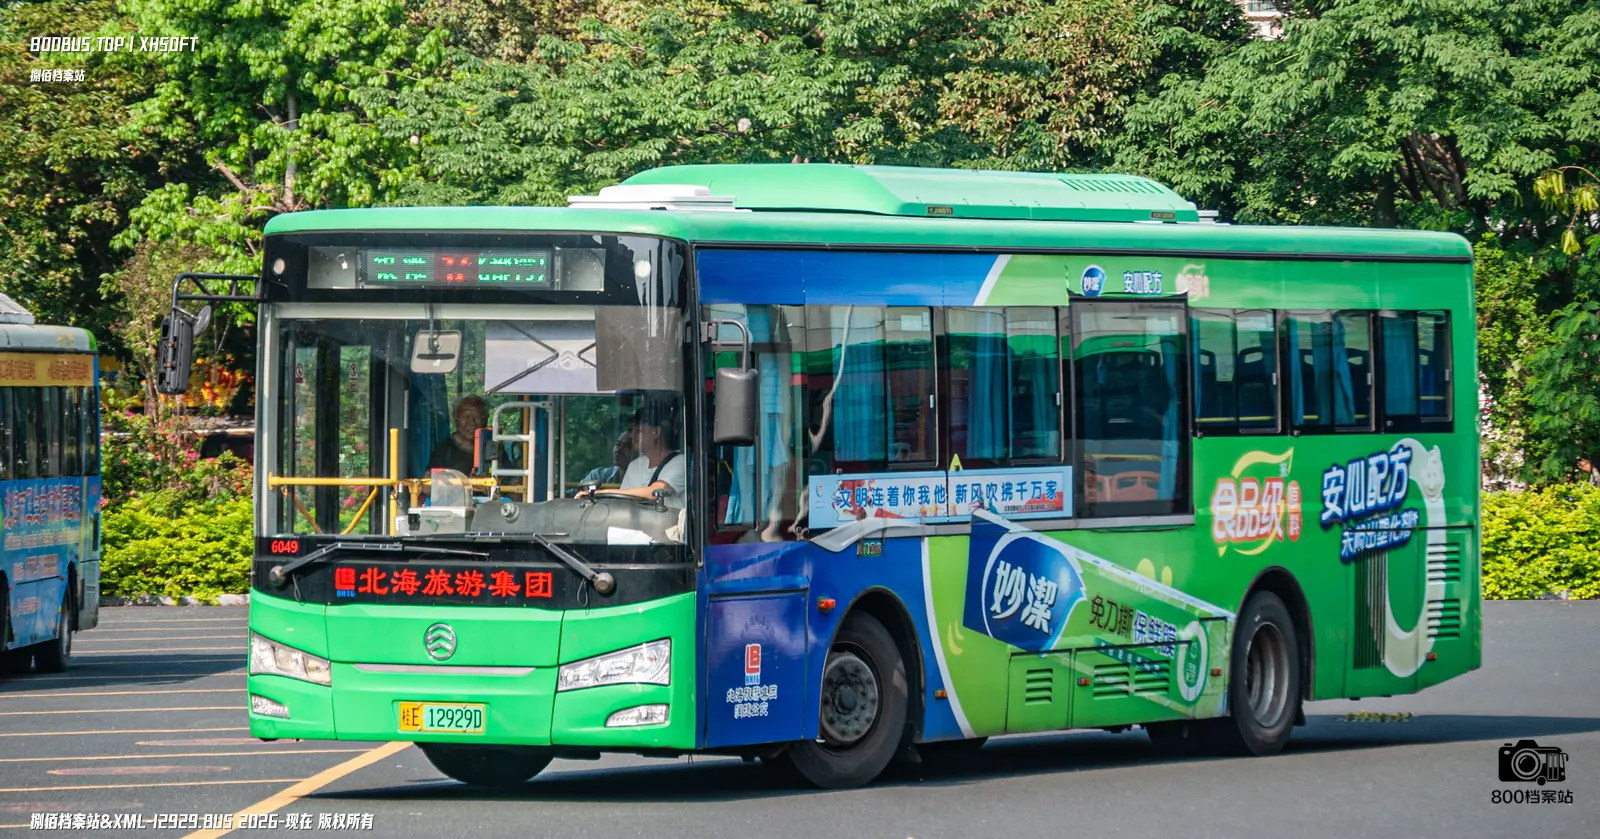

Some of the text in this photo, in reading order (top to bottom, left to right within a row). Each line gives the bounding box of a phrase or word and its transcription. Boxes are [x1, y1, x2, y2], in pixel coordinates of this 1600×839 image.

[1123, 272, 1163, 294] 安心配方
[839, 480, 1058, 509] 文明连着你我他 新风吹拂千万家
[1321, 446, 1411, 522] 安心配方
[1211, 478, 1285, 540] 食品级
[271, 540, 299, 553] 6049
[358, 567, 553, 599] 北海旅游集团
[990, 560, 1057, 633] 妙潔
[402, 708, 482, 728] 桂E 12929D
